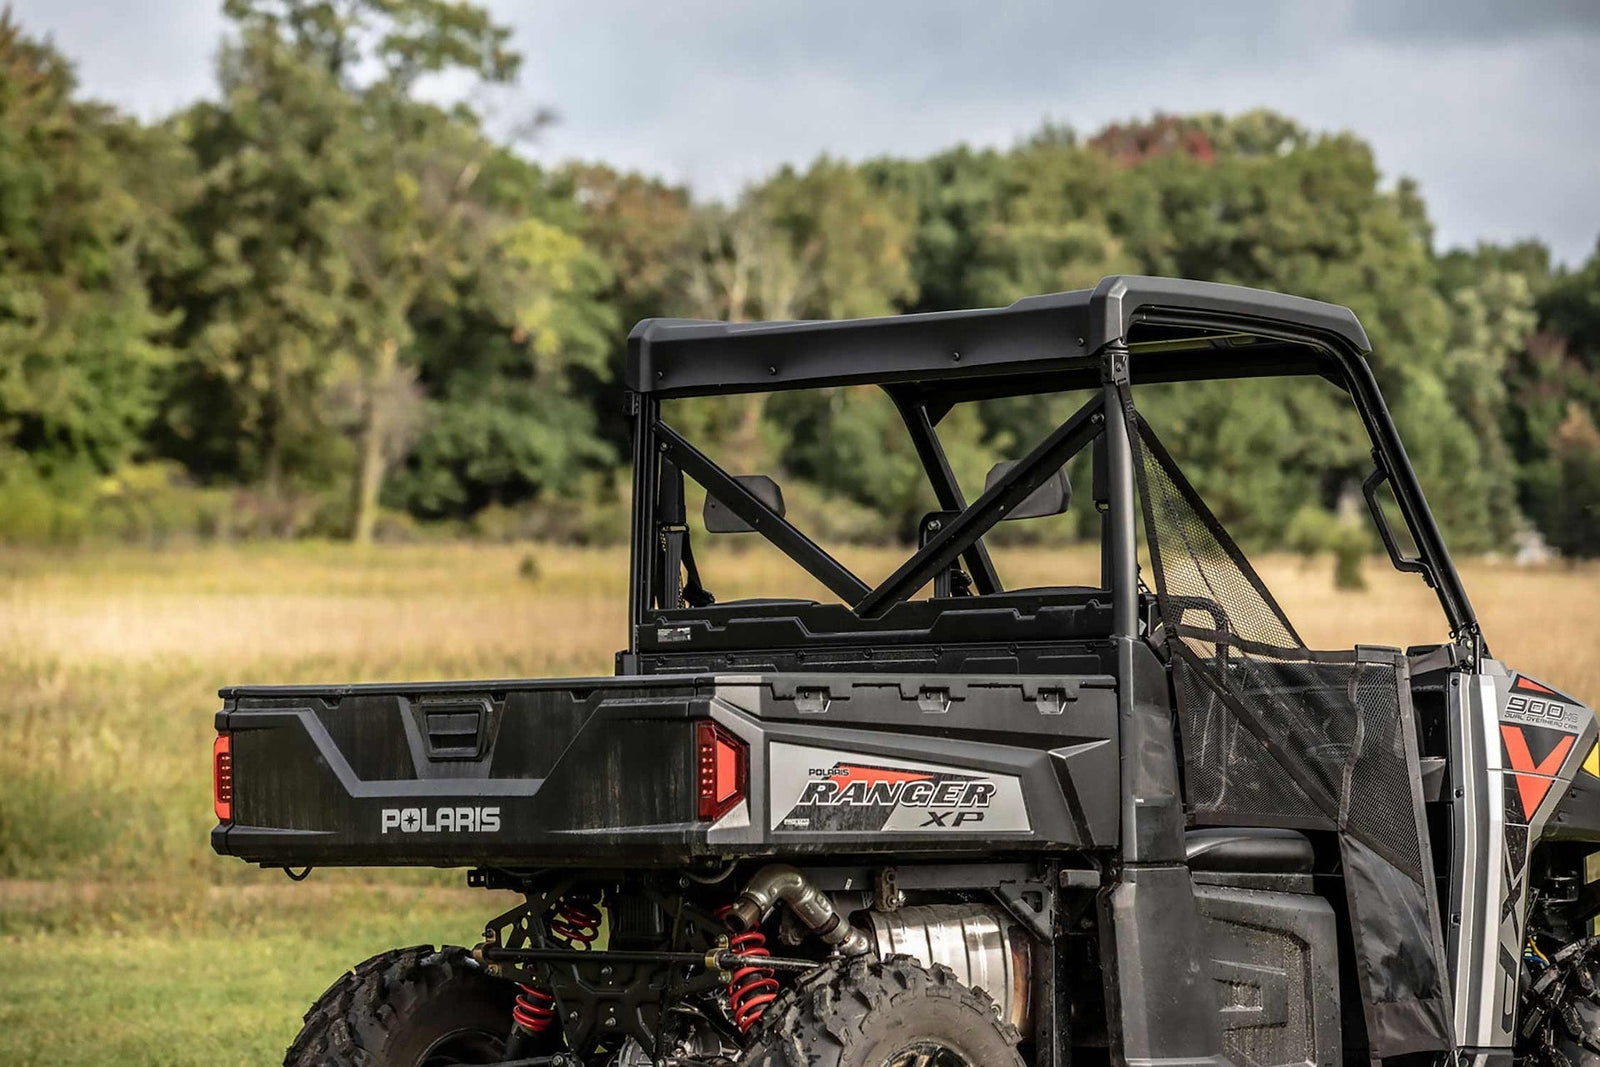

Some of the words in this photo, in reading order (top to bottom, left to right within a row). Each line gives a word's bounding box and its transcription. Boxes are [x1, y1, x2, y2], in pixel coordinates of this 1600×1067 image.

[1505, 696, 1565, 720] 900
[808, 768, 850, 776] POLARIS
[797, 780, 997, 808] RANGER
[381, 807, 501, 834] POLARIS
[919, 811, 985, 828] XP
